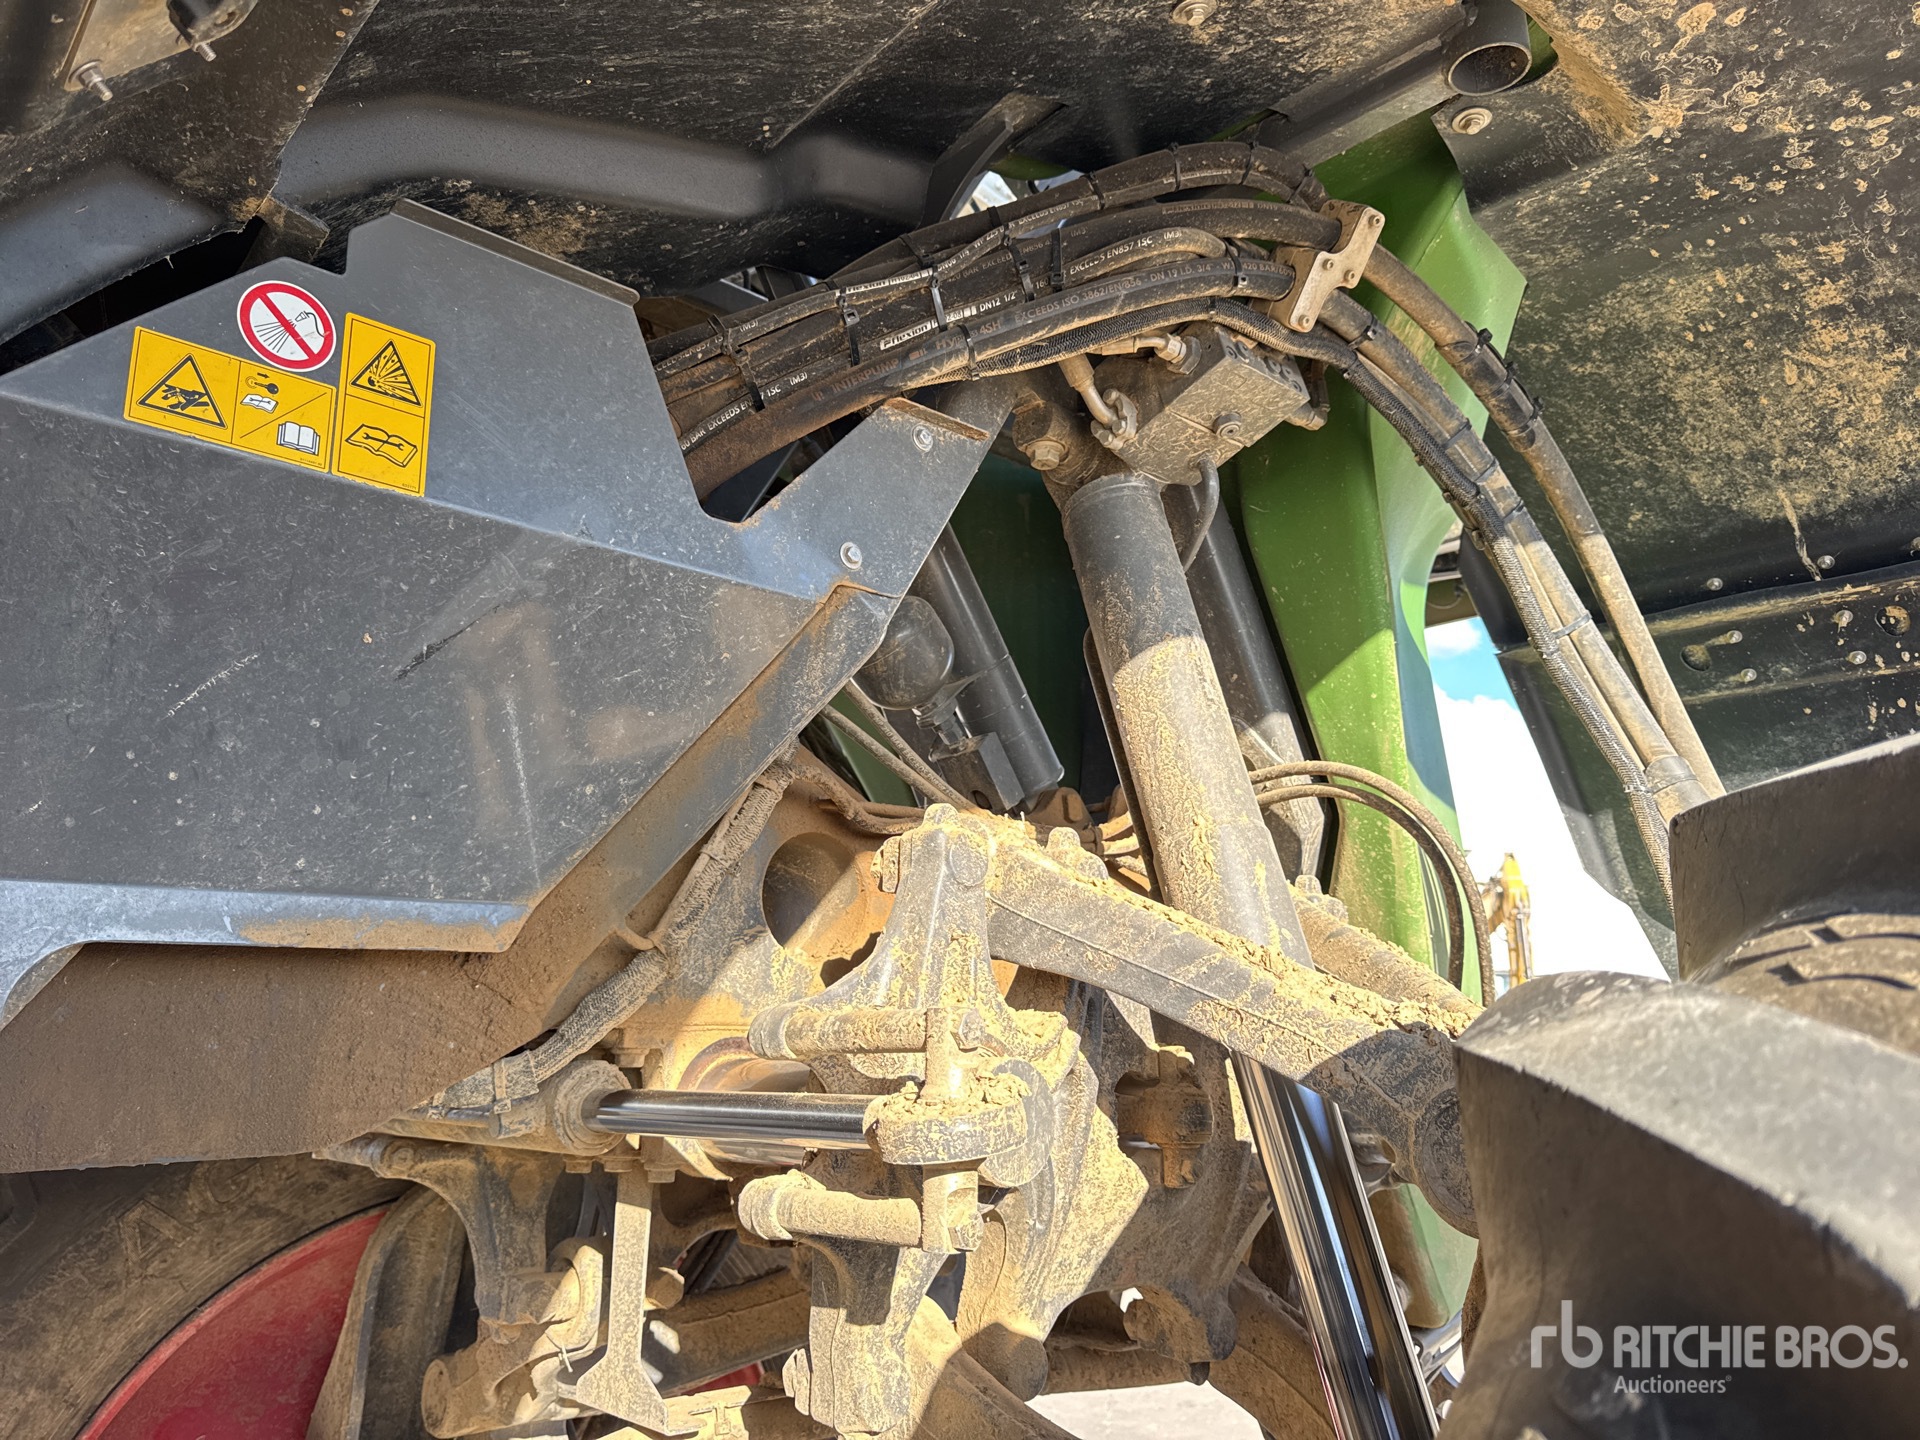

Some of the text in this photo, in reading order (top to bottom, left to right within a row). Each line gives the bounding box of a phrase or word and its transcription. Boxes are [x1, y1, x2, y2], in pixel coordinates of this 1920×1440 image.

[980, 297, 1001, 312] DN12
[1069, 254, 1105, 275] EXCEEDS
[1107, 242, 1134, 259] EN857
[1136, 235, 1153, 248] 1SC
[1163, 230, 1182, 240] (M3)
[982, 251, 1012, 270] EXCEED
[740, 320, 759, 333] (M3)
[832, 359, 900, 393] INTERPUMP
[1015, 302, 1060, 324] EXCEEDS
[1062, 296, 1080, 308] ISO
[1151, 271, 1165, 282] DN
[1167, 269, 1177, 278] 19
[691, 430, 706, 444] BAR
[708, 407, 740, 431] EXCEEDS
[767, 384, 782, 397] 1SC
[790, 371, 808, 386] (M3)
